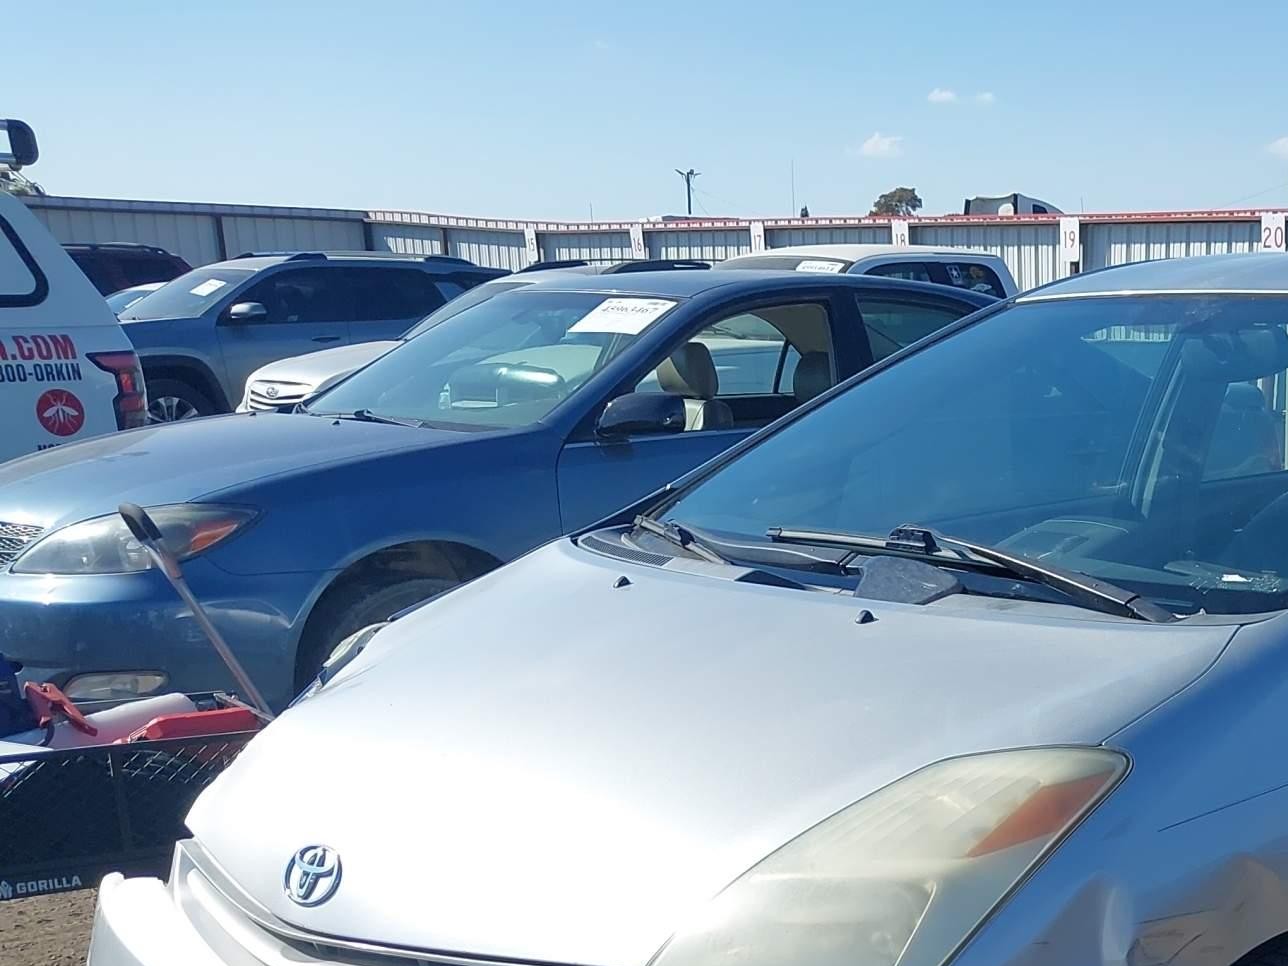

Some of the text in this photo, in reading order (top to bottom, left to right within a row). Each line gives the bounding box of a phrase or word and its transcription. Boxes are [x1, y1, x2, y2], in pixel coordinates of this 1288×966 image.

[527, 237, 535, 251] 15
[633, 237, 642, 252] 16
[753, 234, 762, 250] 17
[895, 233, 905, 248] 18
[1064, 230, 1076, 249] 19
[1263, 226, 1284, 248] 20
[16, 875, 82, 894] GORILLA
